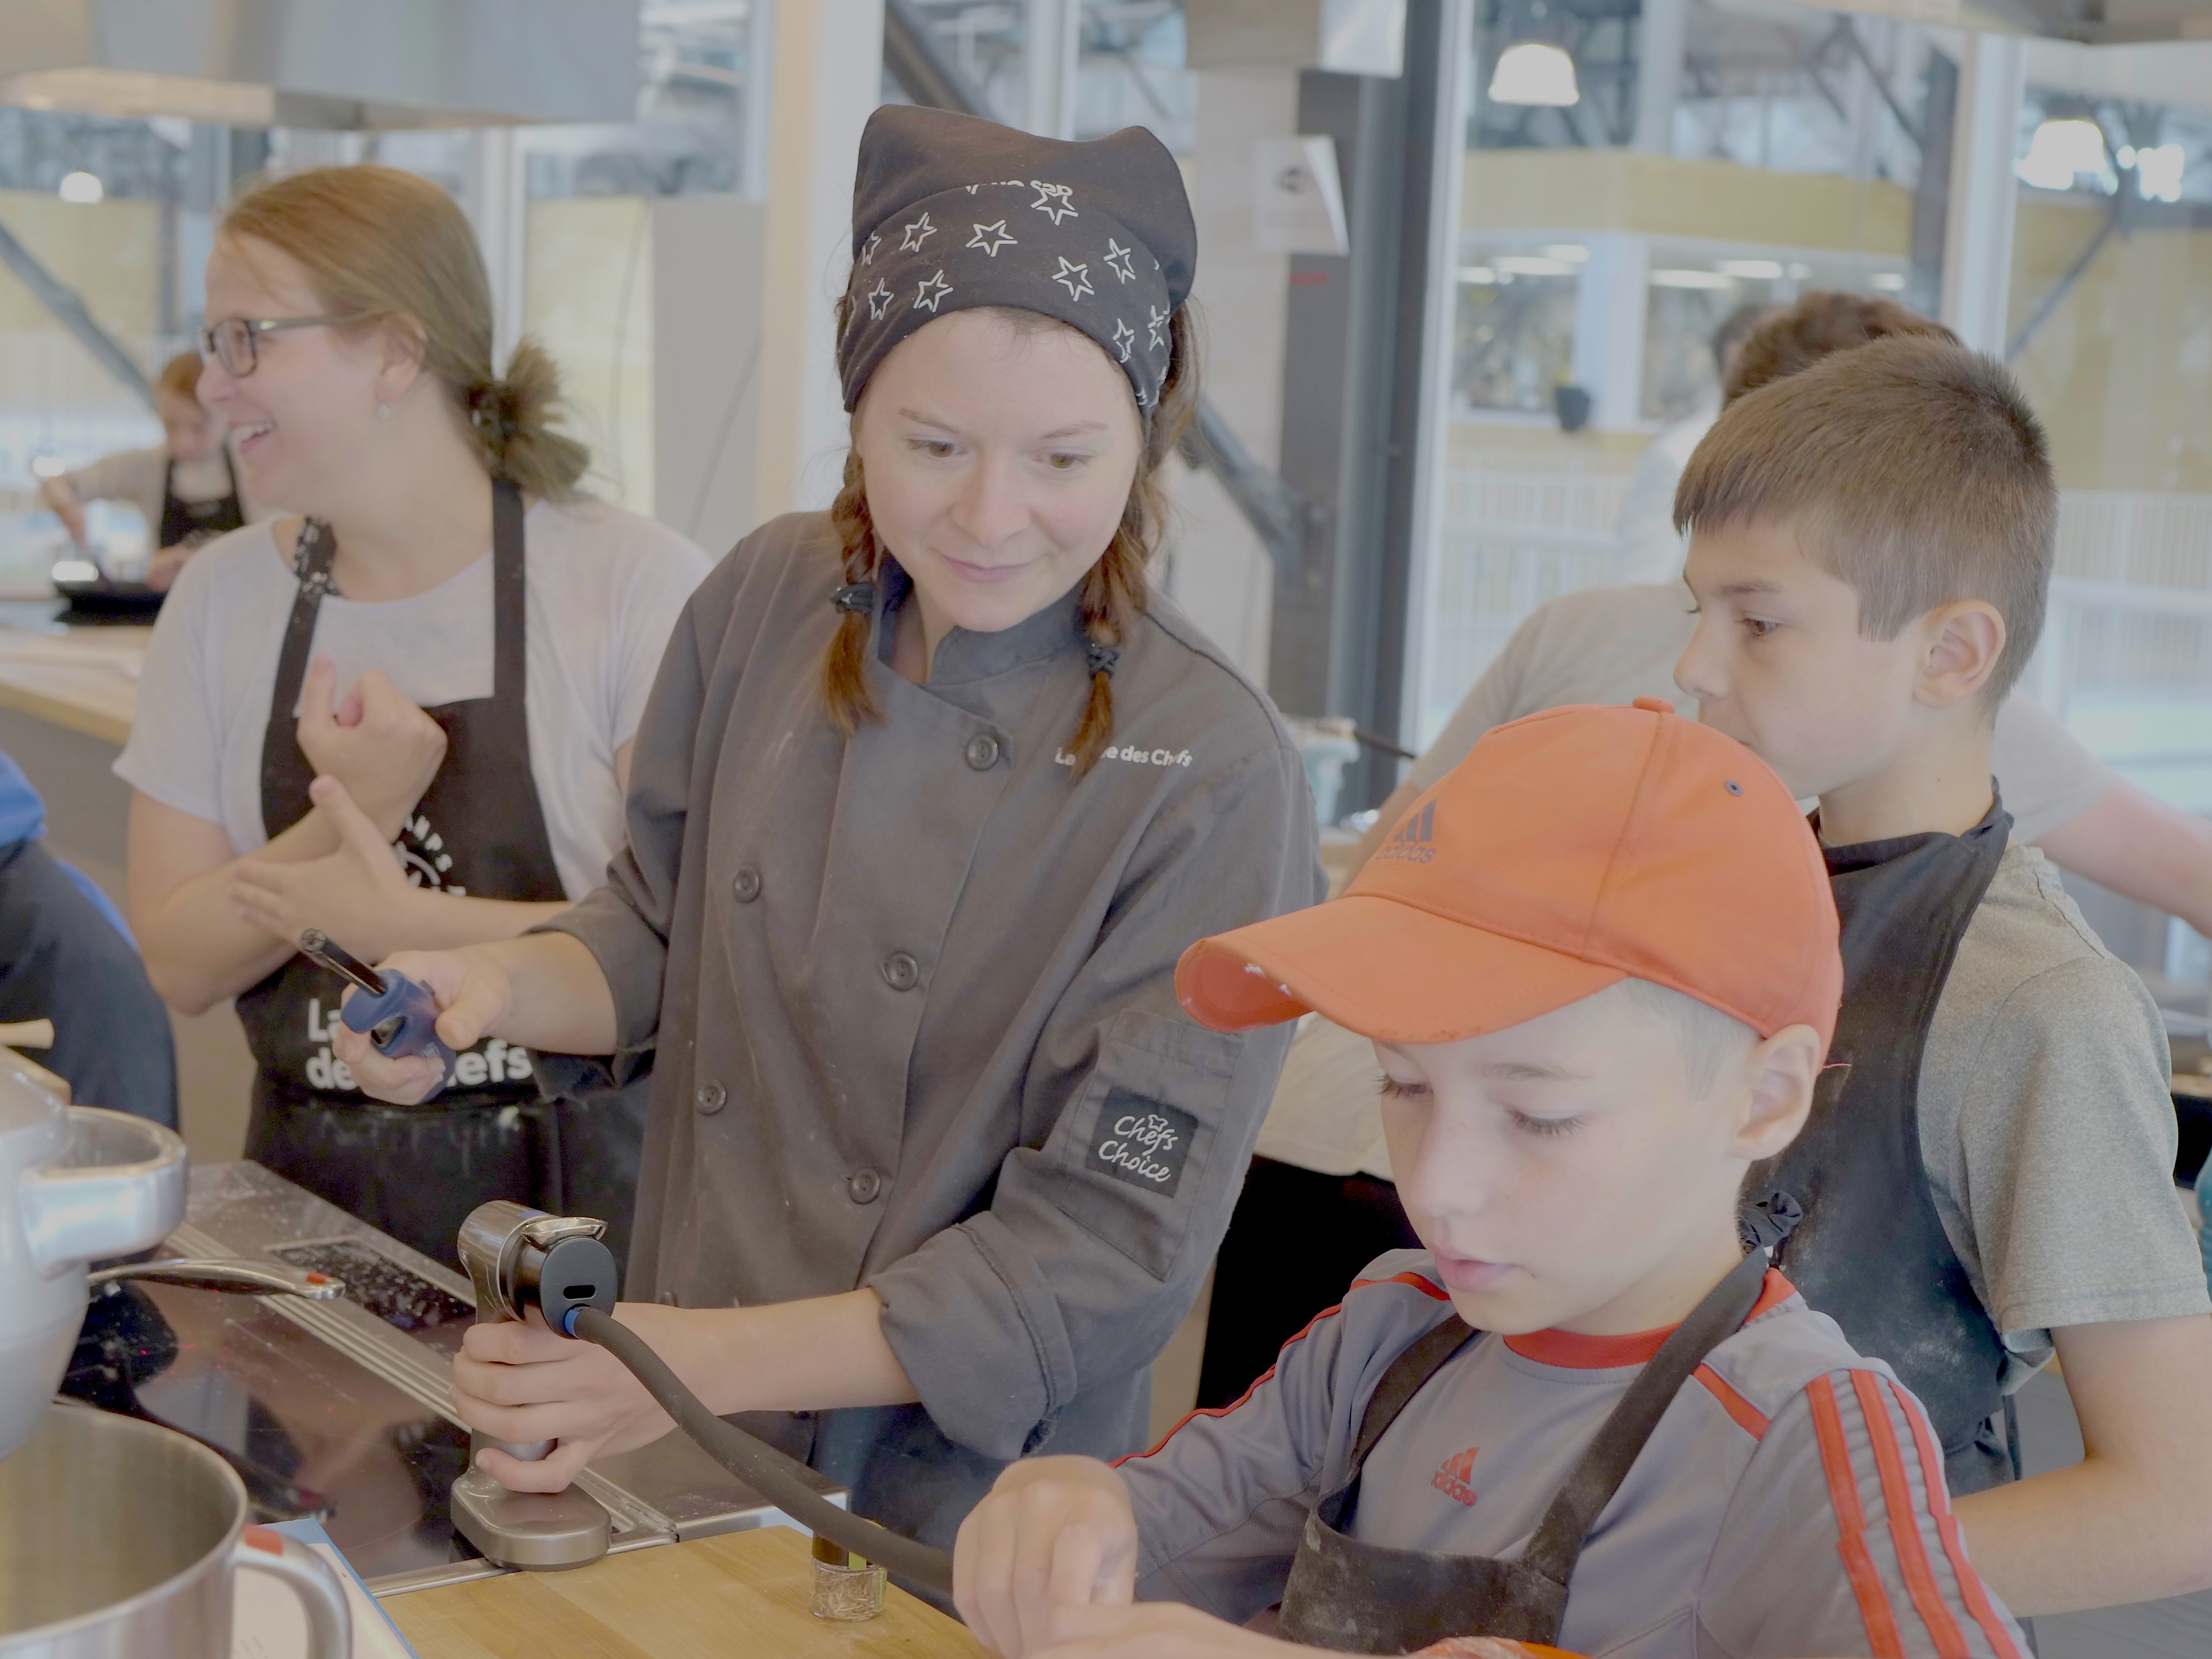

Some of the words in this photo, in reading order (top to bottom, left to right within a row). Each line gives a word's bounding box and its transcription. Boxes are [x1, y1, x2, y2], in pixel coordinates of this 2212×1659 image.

[1054, 746, 1076, 765] La
[1120, 745, 1149, 763] des
[1151, 748, 1193, 767] Chfs
[1114, 1115, 1179, 1157] Chefs
[1098, 1140, 1171, 1182] Choice
[1431, 1470, 1477, 1507] didas
